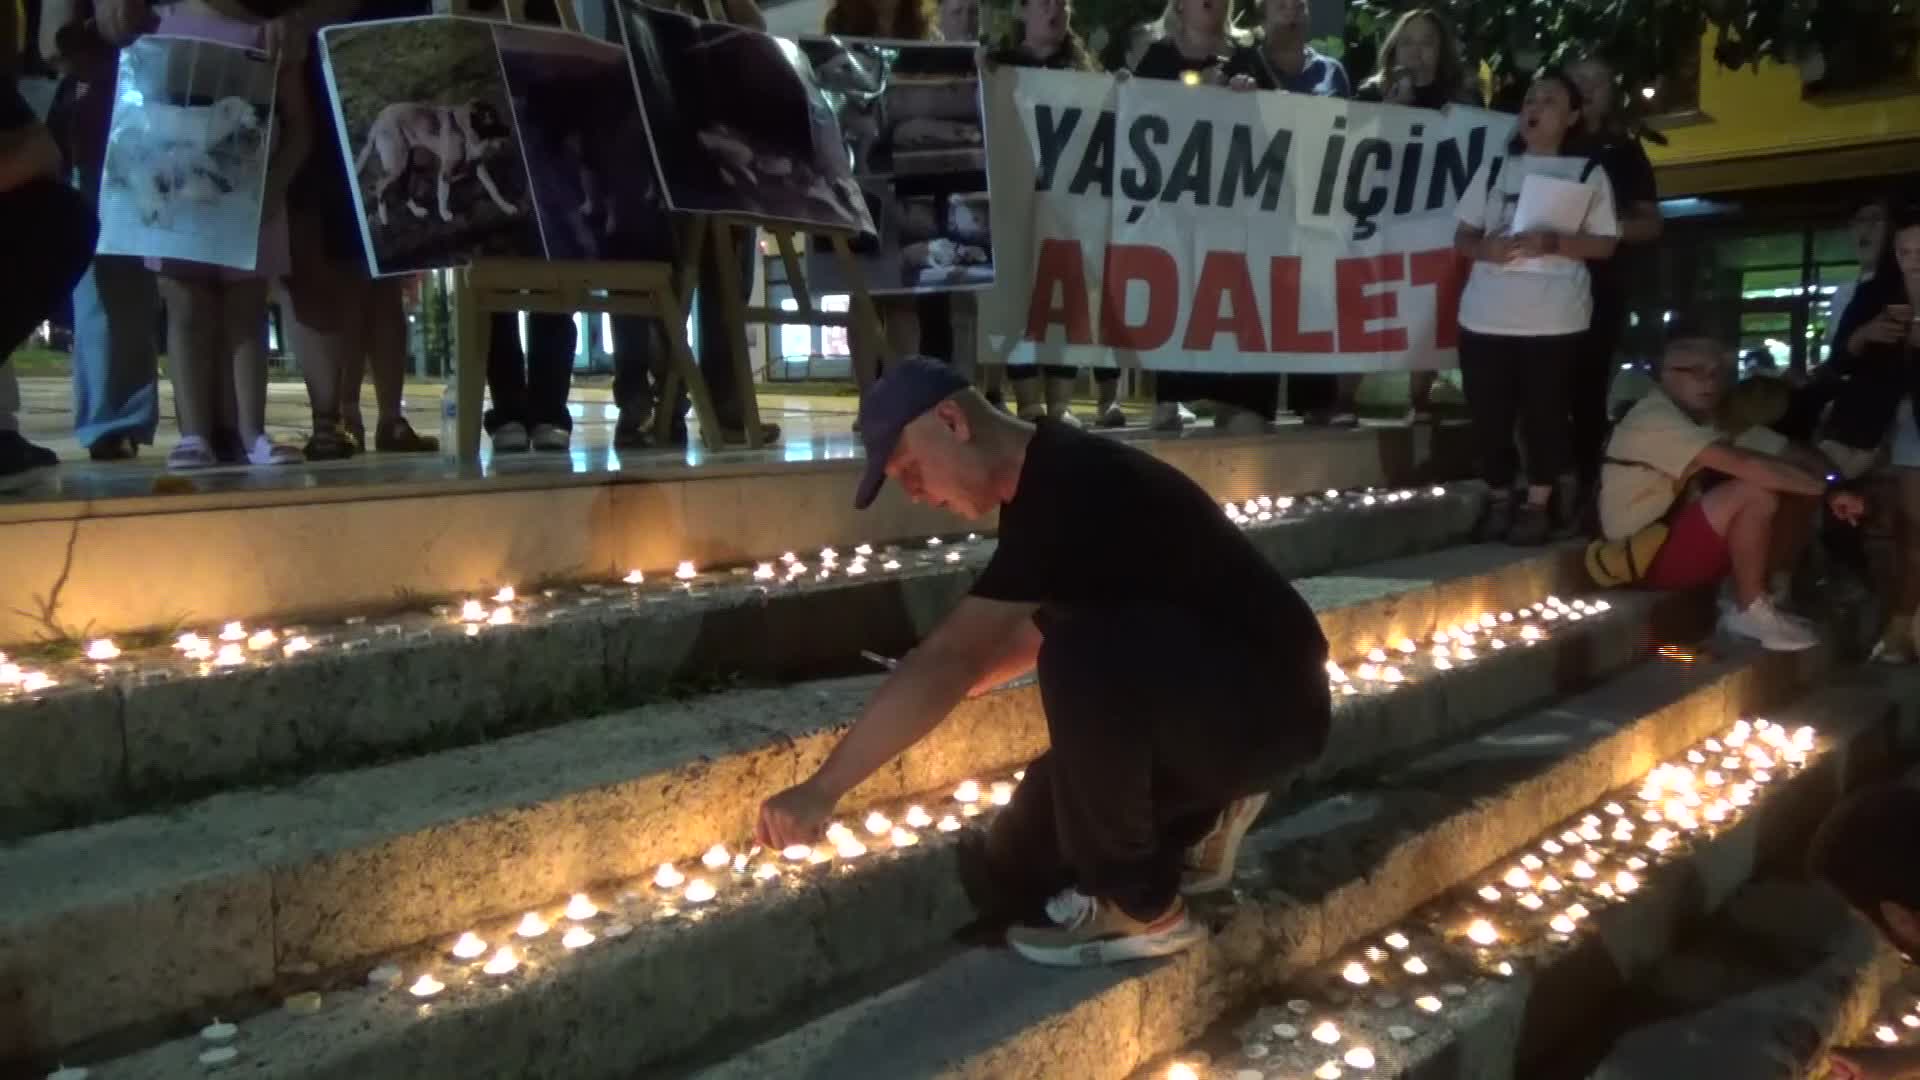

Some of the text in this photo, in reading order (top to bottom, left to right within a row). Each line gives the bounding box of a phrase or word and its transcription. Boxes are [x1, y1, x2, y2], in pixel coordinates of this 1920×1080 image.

[1034, 104, 1487, 239] YAŞAM İÇİN
[1026, 239, 1466, 352] ADALET
